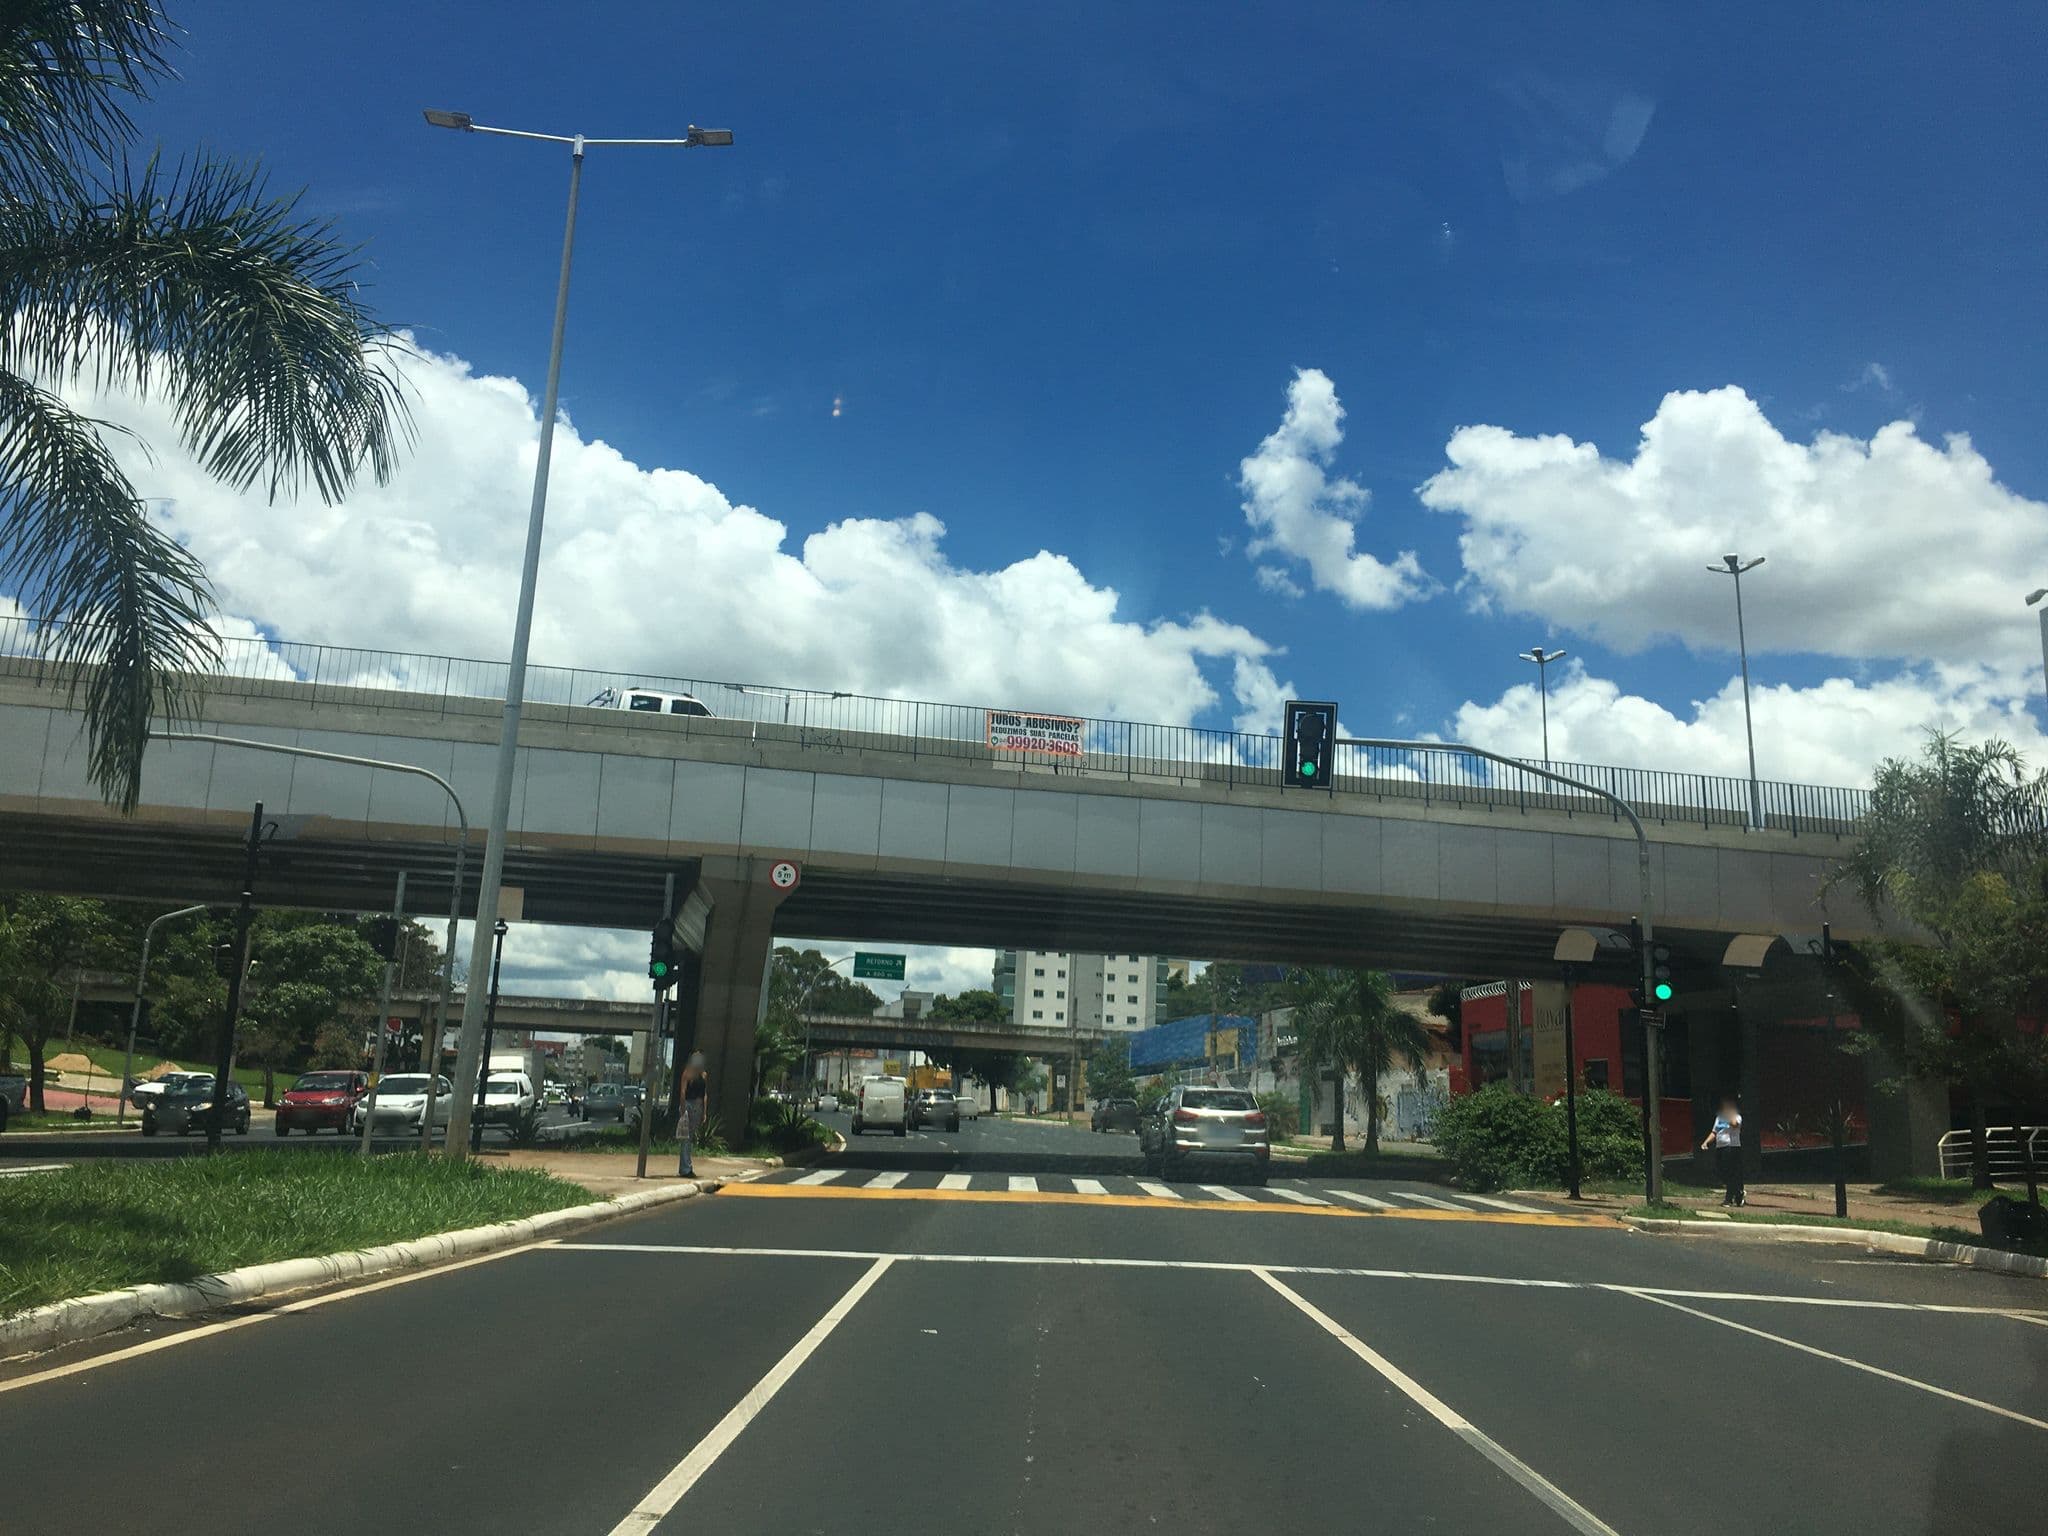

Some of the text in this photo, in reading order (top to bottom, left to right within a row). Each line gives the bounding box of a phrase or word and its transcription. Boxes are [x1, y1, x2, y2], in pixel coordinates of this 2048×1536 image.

[991, 714, 1080, 733] JUROS ABUSIVOS?
[991, 727, 1079, 741] REDUZIMOS SUAS PARCELAS
[866, 958, 893, 966] RETORNO
